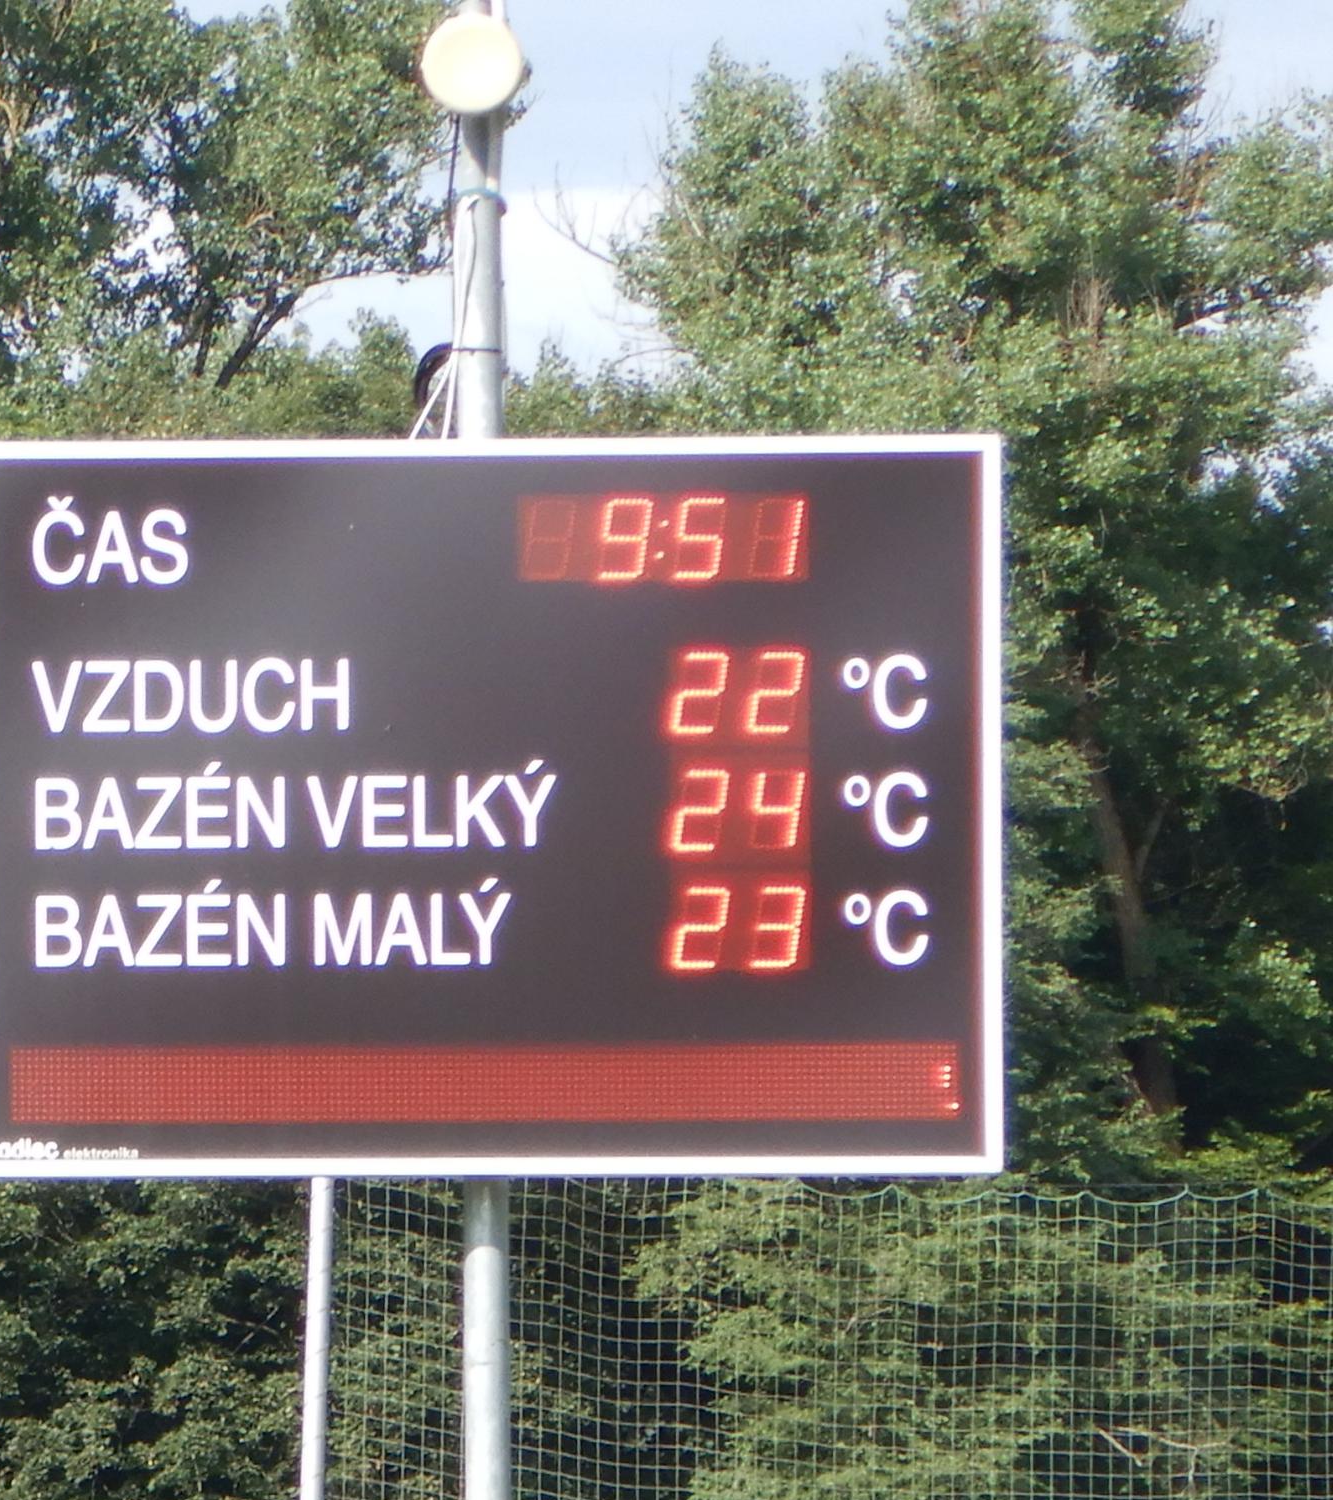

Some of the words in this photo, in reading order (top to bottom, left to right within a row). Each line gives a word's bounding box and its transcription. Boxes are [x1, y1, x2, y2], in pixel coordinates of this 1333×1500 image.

[31, 495, 189, 587] ČAS
[596, 496, 806, 582] 9:51
[32, 656, 351, 734] VZDUCH
[666, 649, 807, 737] 22
[841, 652, 929, 731] °C
[33, 760, 287, 851] BAZÉN
[306, 759, 556, 849] VELKÝ
[667, 767, 806, 854] 24
[842, 770, 929, 848] °C
[34, 879, 287, 968] BAZÉN
[312, 877, 511, 967] MALÝ
[668, 884, 807, 972] 23
[843, 889, 929, 966] °C
[63, 1147, 139, 1159] elektronika
